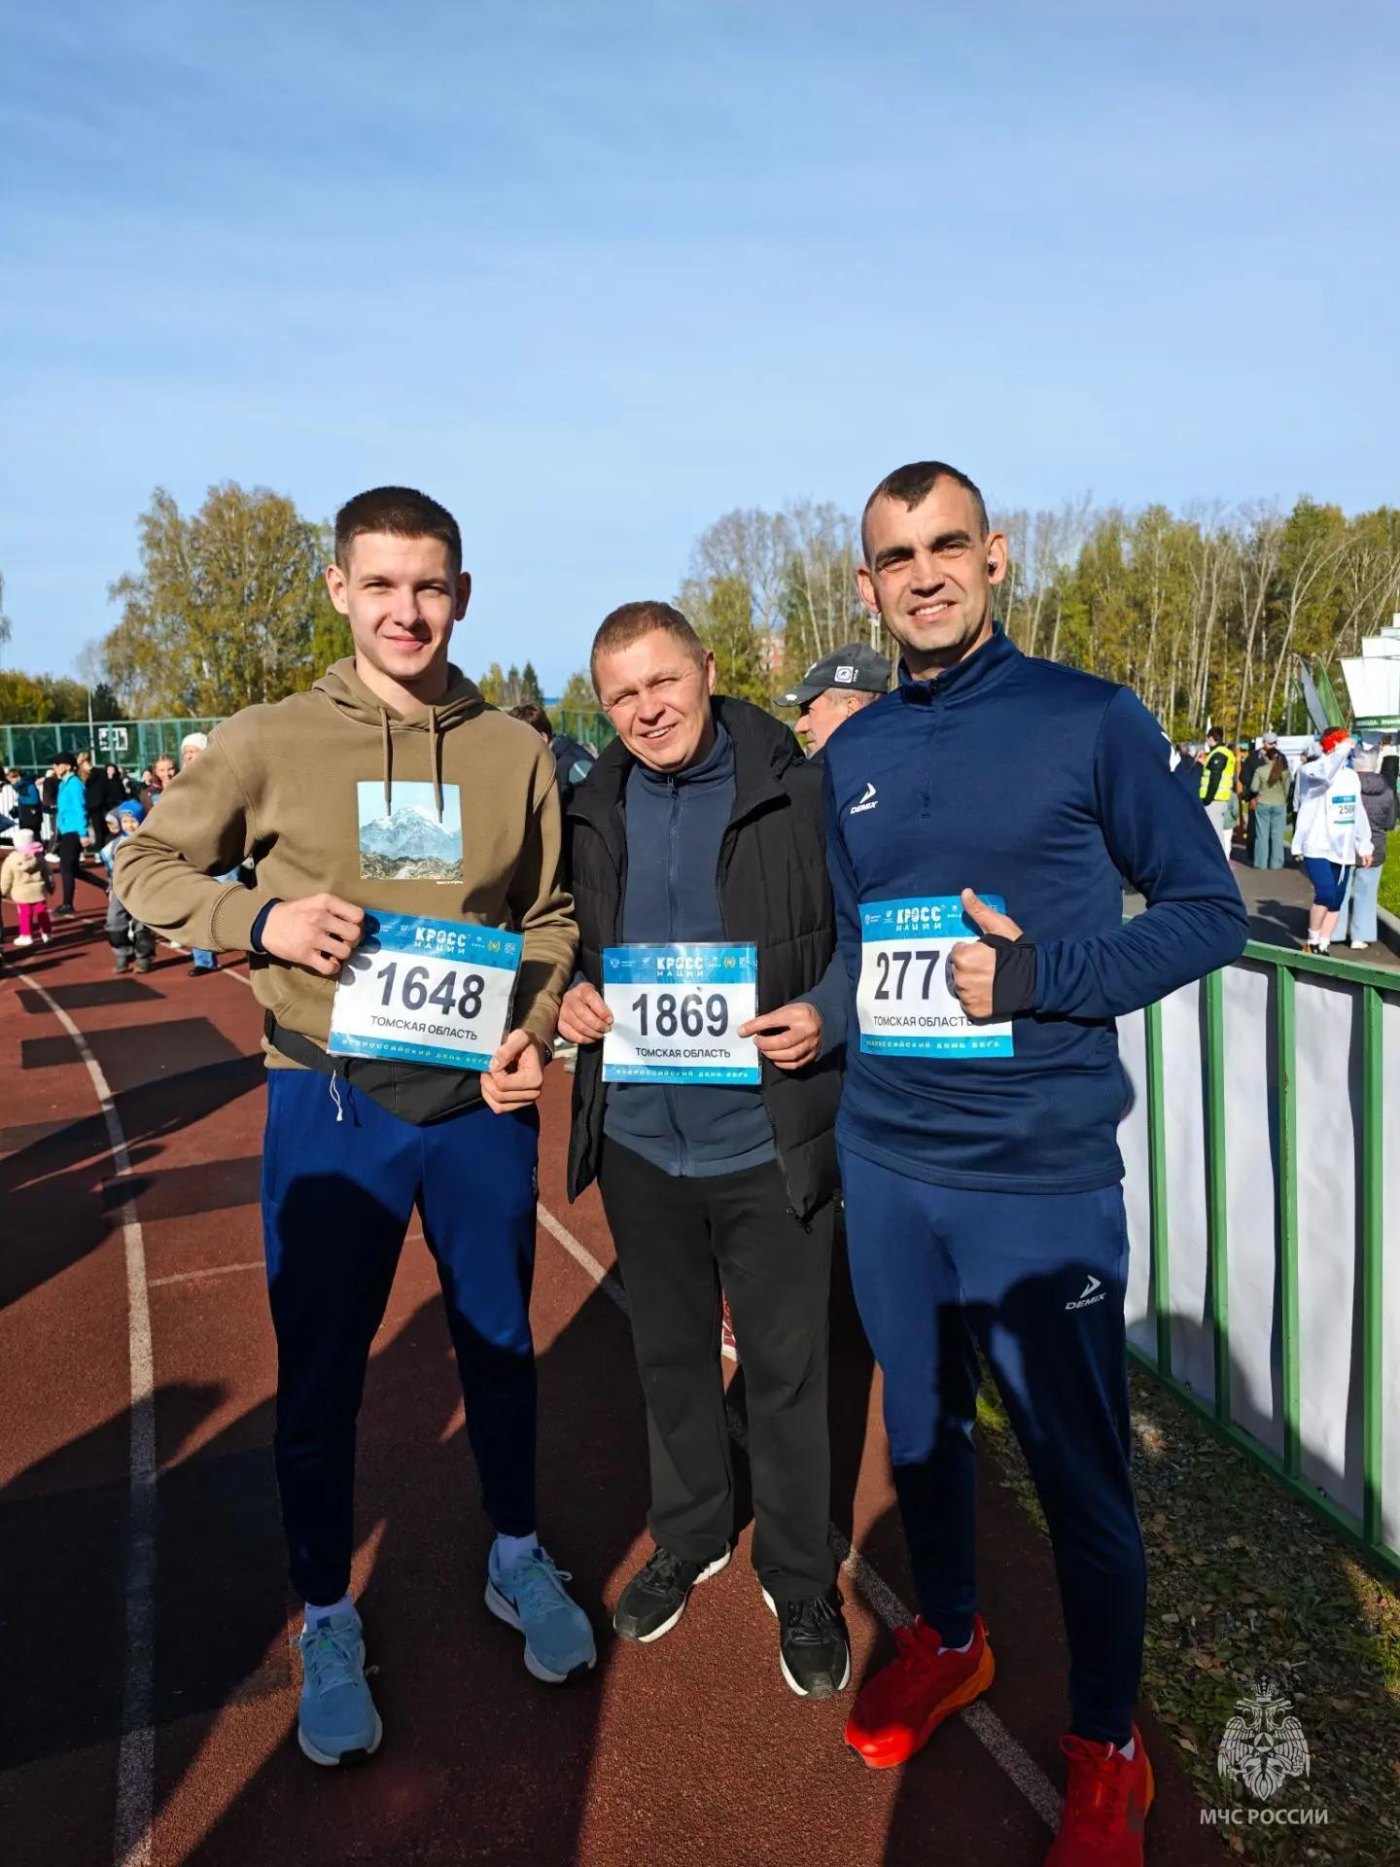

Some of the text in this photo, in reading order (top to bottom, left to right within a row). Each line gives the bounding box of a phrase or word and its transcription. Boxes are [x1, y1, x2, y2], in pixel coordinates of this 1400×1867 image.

[897, 906, 941, 924] КРОСС
[896, 923, 942, 931] НАЦИИ
[415, 926, 467, 948] КРОСС
[656, 957, 704, 970] КРОСС
[874, 950, 957, 1000] 277
[377, 962, 485, 1019] 1648
[632, 993, 729, 1037] 1869
[873, 1015, 916, 1027] ТОМСКАЯ
[370, 1015, 477, 1041] ТОМСКАЯ ОБЛАСТЬ
[635, 1047, 731, 1058] ТОМСКАЯ ОБЛАСТЬ
[1065, 1292, 1107, 1310] DEMIX
